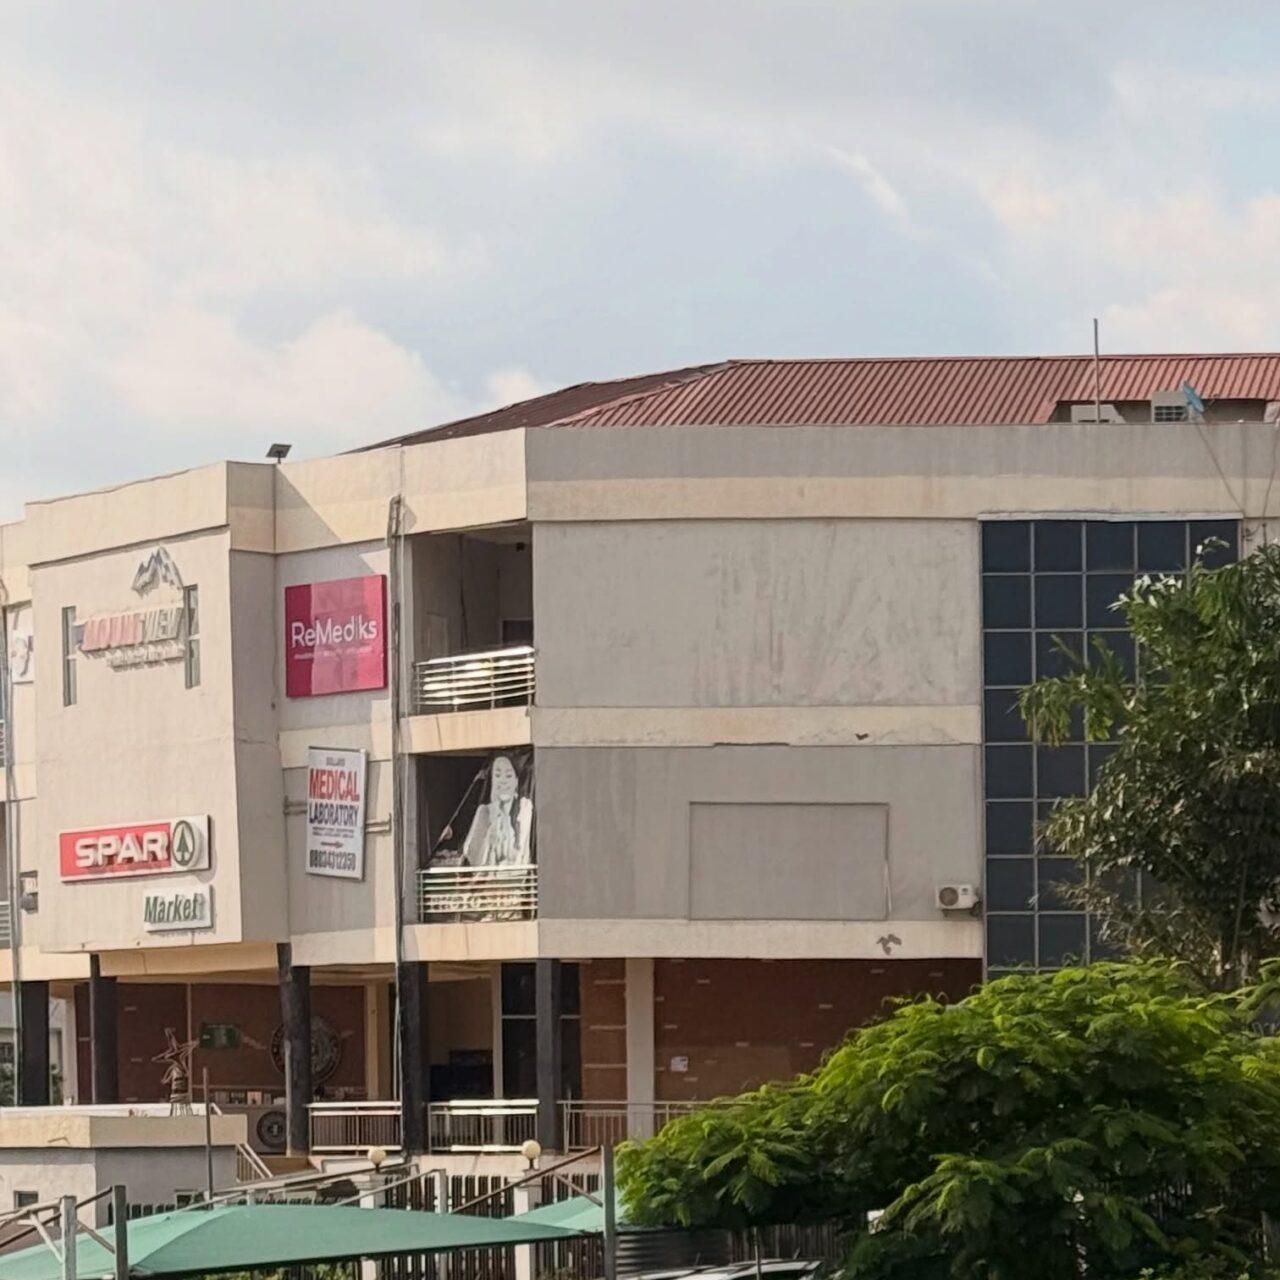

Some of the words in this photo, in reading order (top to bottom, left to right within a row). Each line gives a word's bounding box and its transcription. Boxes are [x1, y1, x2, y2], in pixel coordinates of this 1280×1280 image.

[309, 767, 360, 802] MEDICAL
[308, 801, 360, 828] LABORATORY
[75, 830, 169, 868] SPAR
[143, 892, 203, 924] Market
